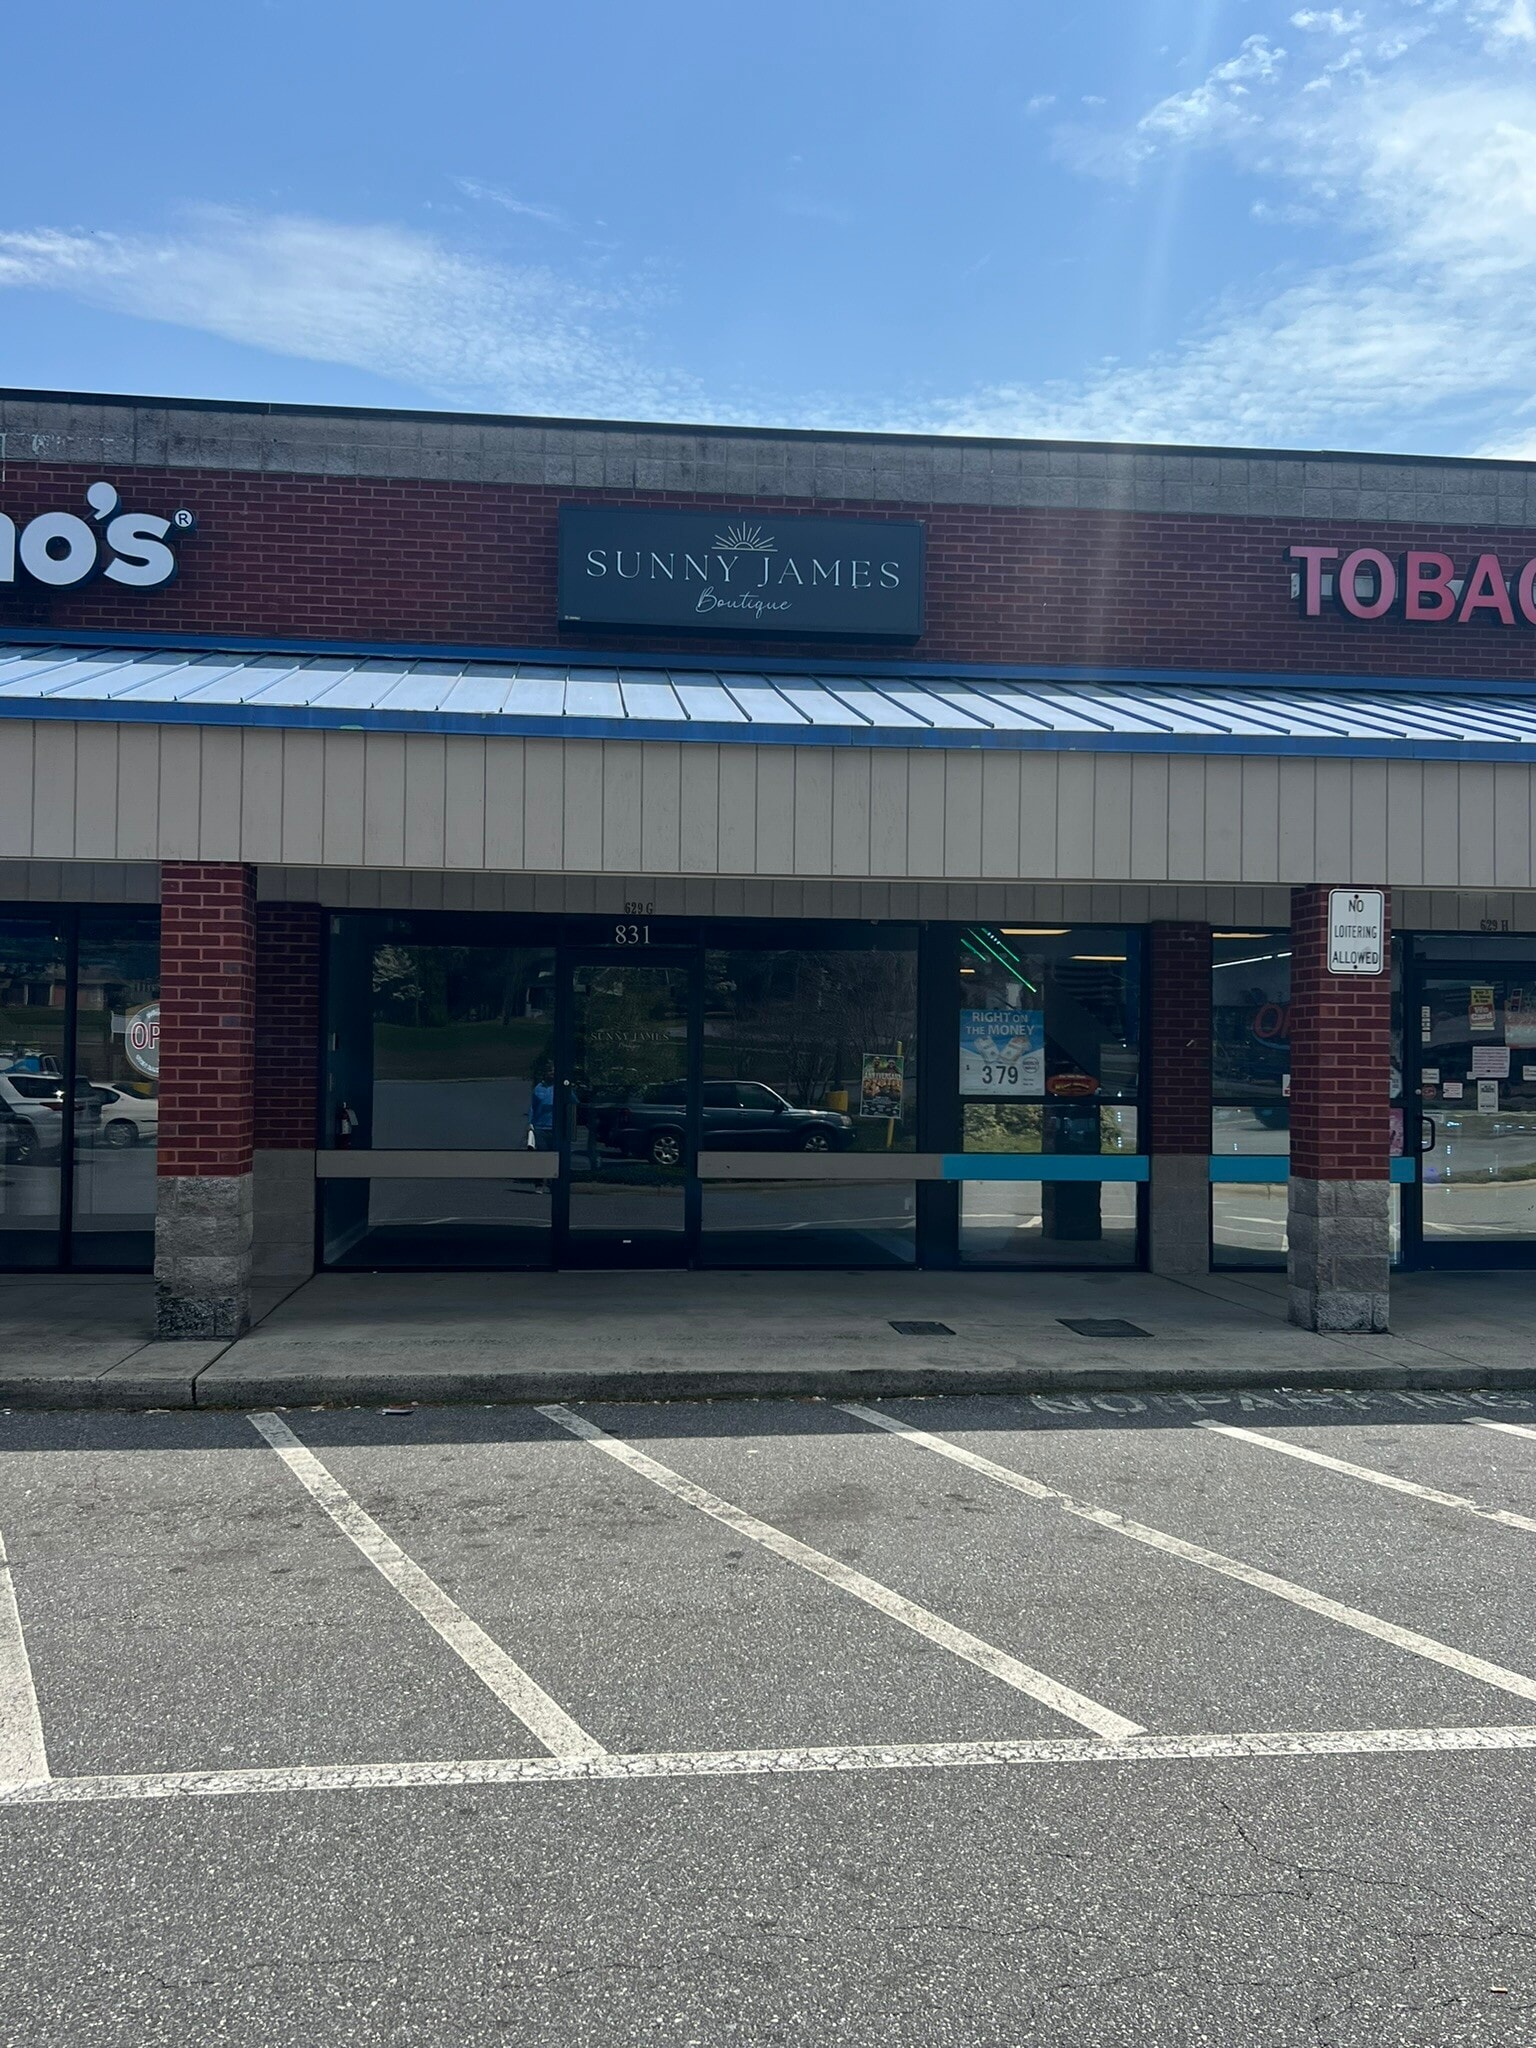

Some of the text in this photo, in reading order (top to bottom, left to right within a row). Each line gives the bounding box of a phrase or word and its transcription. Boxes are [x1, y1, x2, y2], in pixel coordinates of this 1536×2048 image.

[0, 482, 174, 586] o's
[586, 549, 900, 589] SUNNY JAMES
[695, 586, 793, 619] Boutique
[624, 902, 654, 915] 629 G
[1348, 899, 1365, 913] NO
[1334, 925, 1378, 939] LOITERING
[1480, 919, 1498, 931] 629
[615, 924, 651, 944] 831
[1331, 951, 1379, 965] ALLOWED
[972, 1011, 1029, 1023] RIGHT ON
[966, 1024, 1035, 1036] THE MONEY
[1030, 1389, 1534, 1414] NO PARKING
